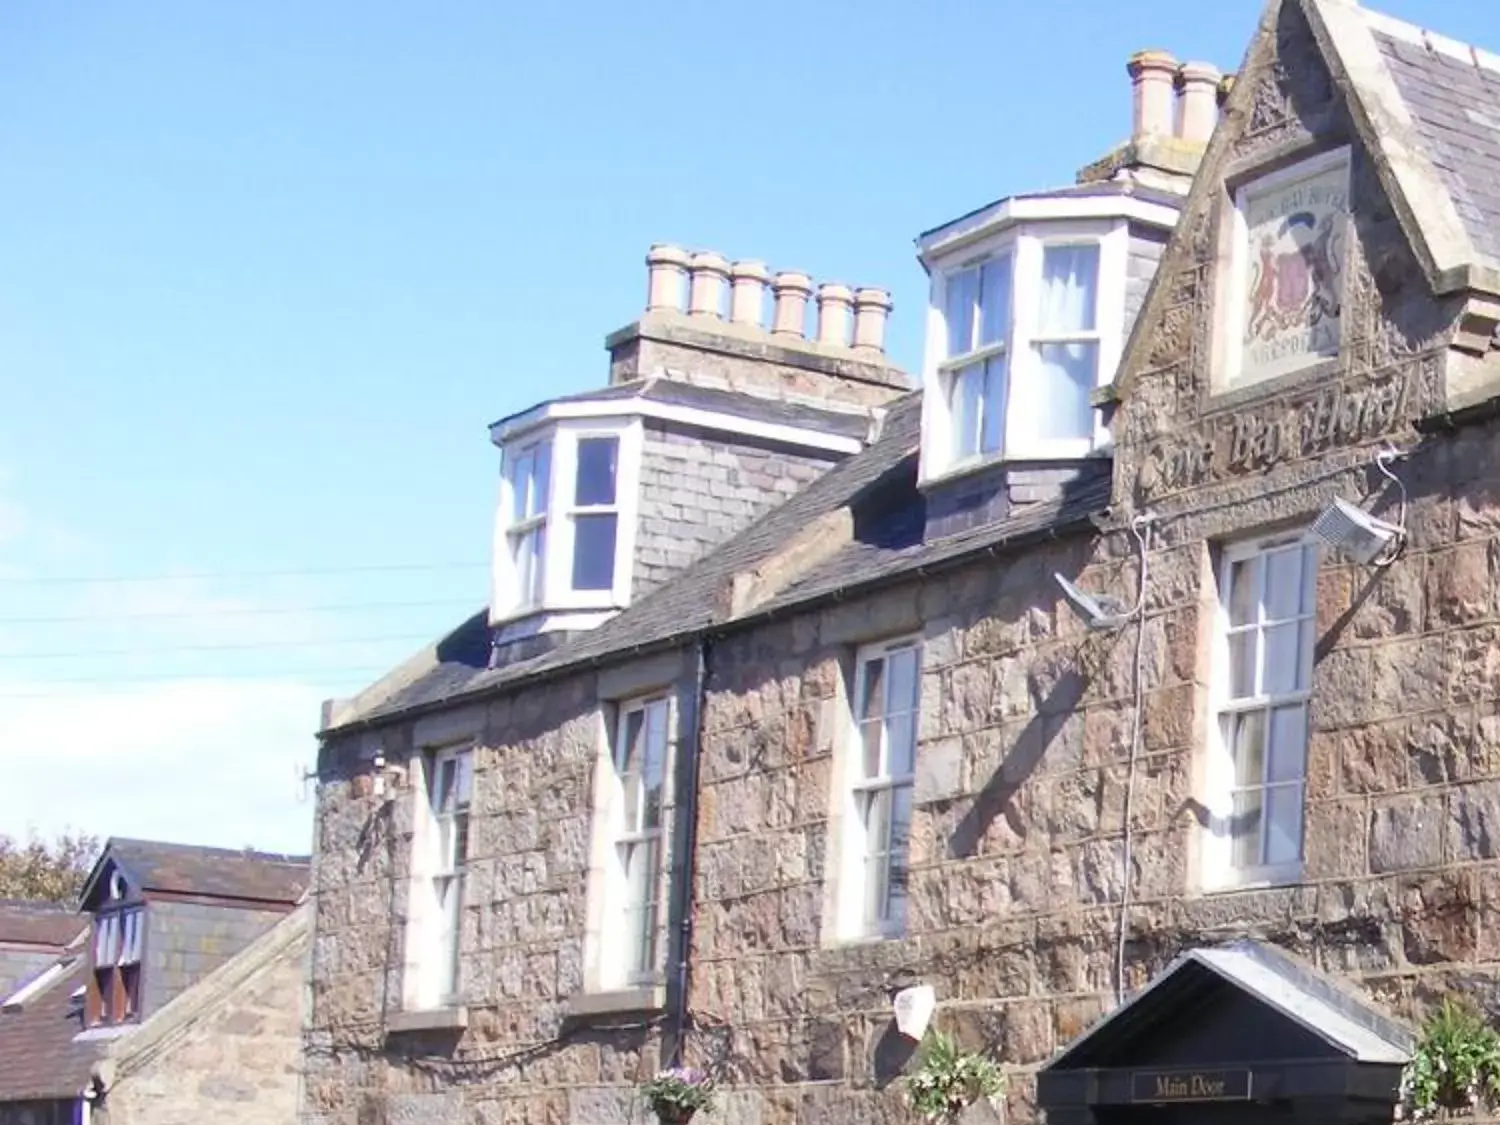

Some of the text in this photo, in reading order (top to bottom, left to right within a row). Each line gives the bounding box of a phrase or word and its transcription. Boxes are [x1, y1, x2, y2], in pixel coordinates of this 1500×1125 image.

[1229, 411, 1284, 474] Bay
[1302, 372, 1410, 450] Hotel
[1155, 1074, 1226, 1097] Main Door
